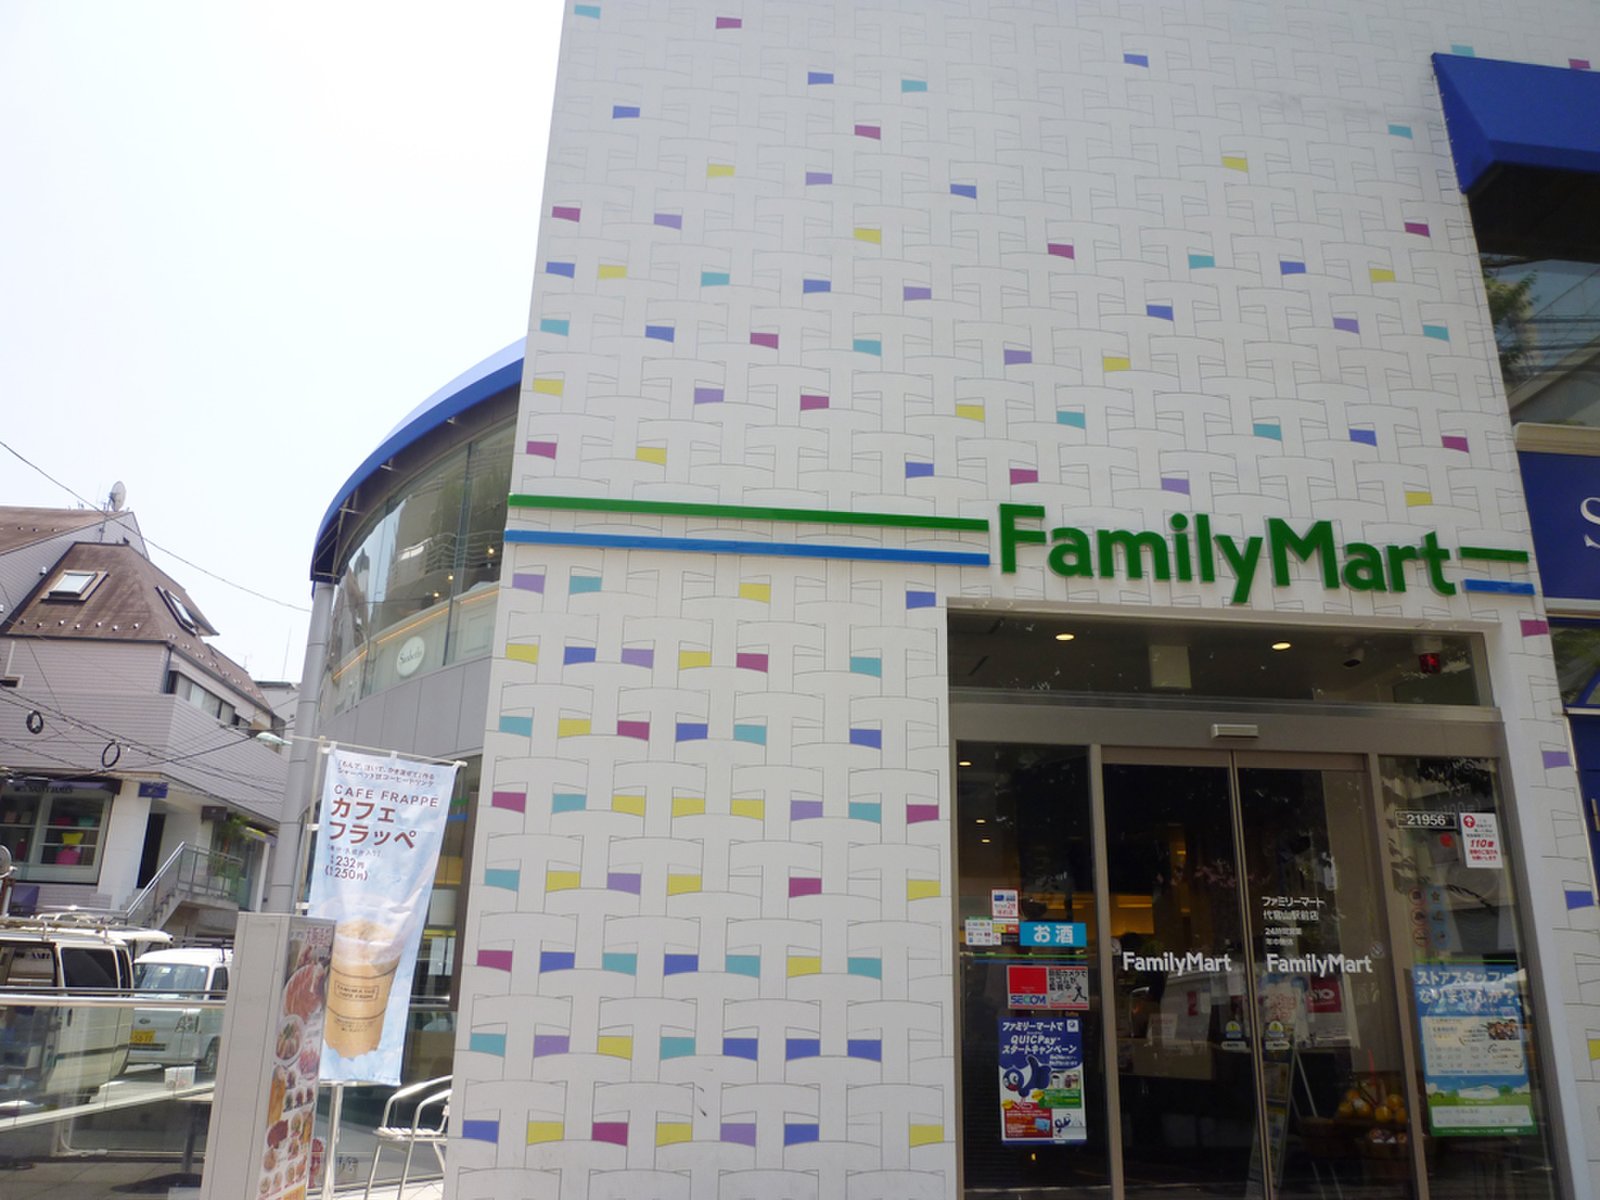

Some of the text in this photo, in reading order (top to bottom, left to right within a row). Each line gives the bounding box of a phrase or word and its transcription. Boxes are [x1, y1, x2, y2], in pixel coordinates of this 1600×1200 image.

[999, 503, 1456, 604] FamilyMart
[331, 798, 396, 823] カフェ
[1406, 814, 1446, 826] 21956
[329, 821, 417, 849] フラッペ
[1261, 896, 1325, 909] ファミリーマート
[1033, 924, 1074, 944] お酒
[1122, 951, 1232, 976] FamilyMart
[1266, 953, 1373, 978] FamilyMart
[1010, 994, 1047, 1006] SECOM
[1002, 1021, 1064, 1032] ファミリーマートで
[1011, 1034, 1057, 1046] QUICPay
[1002, 1045, 1078, 1055] スタートキャンペーン
